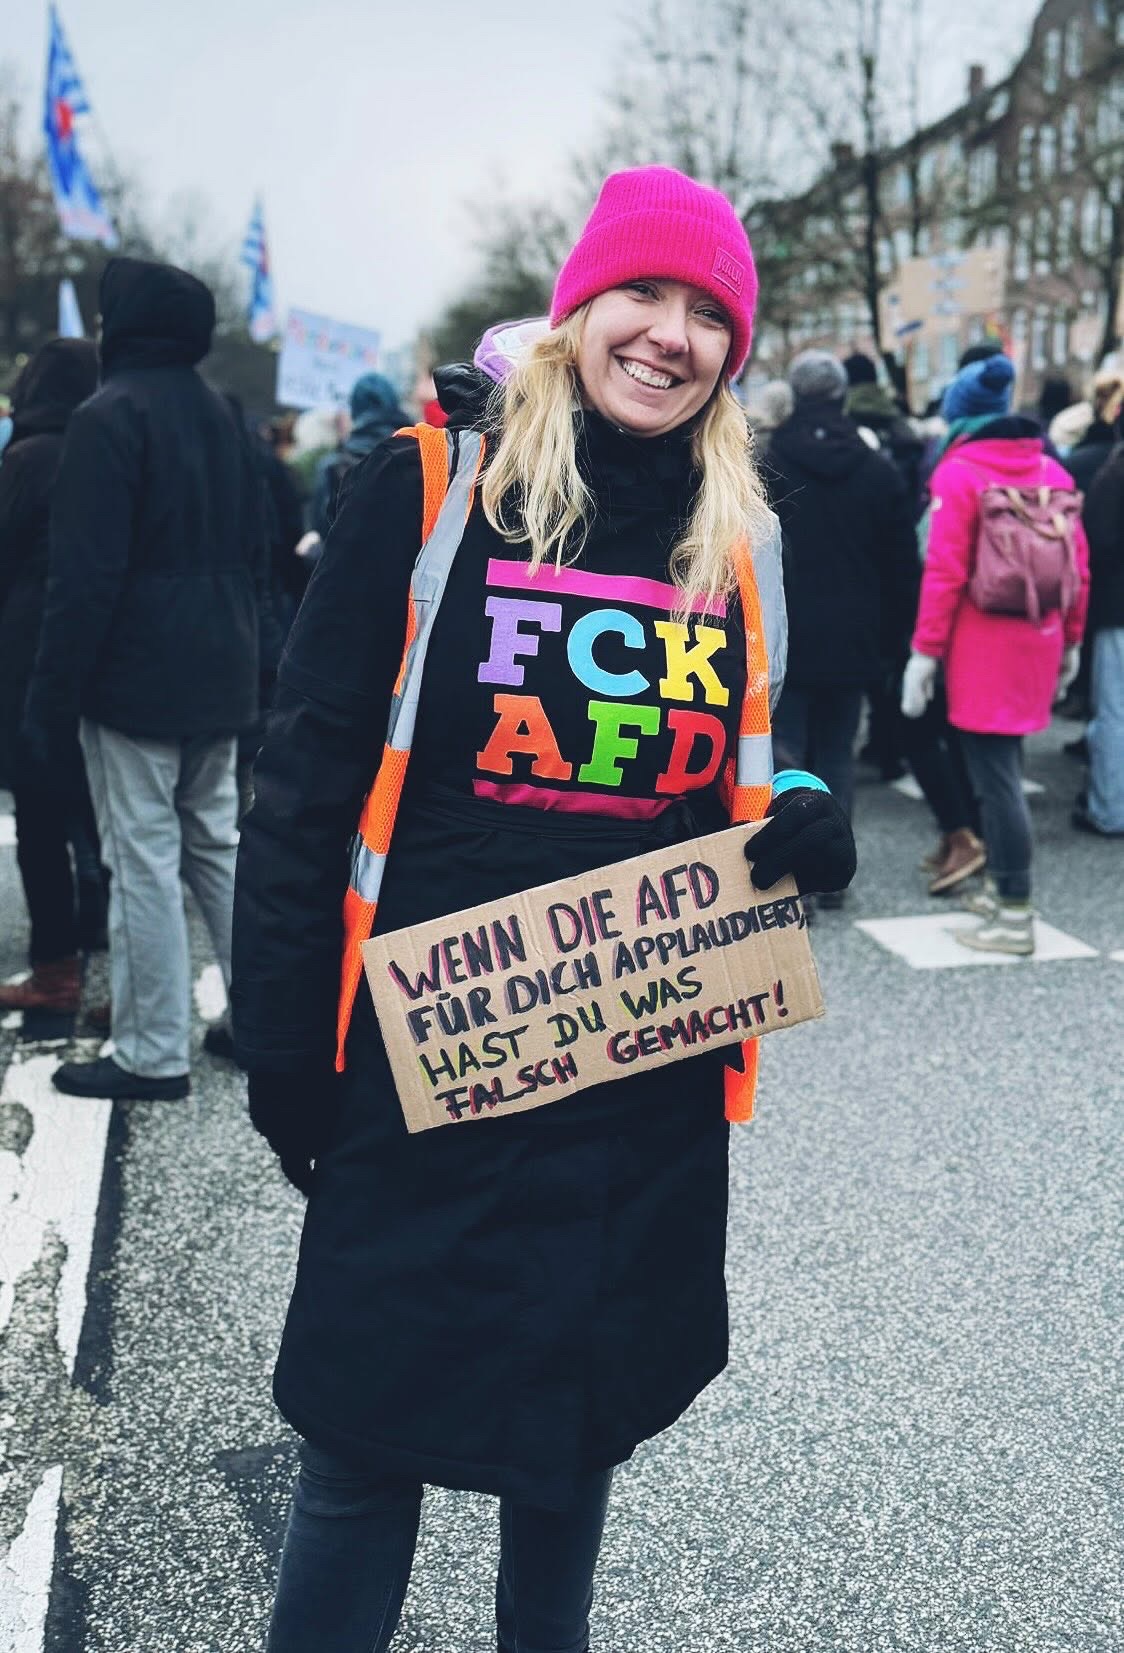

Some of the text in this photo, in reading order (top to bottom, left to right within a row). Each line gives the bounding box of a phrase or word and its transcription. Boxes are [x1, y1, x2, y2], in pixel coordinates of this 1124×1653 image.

[477, 595, 730, 706] FCK
[476, 693, 727, 795] AFD
[387, 862, 720, 1000] WENN DIE AFD
[405, 986, 499, 1046] FÜR
[504, 951, 602, 1015] DICH
[416, 966, 703, 1087] HAST DU WAS
[434, 1052, 578, 1120] FALSCH
